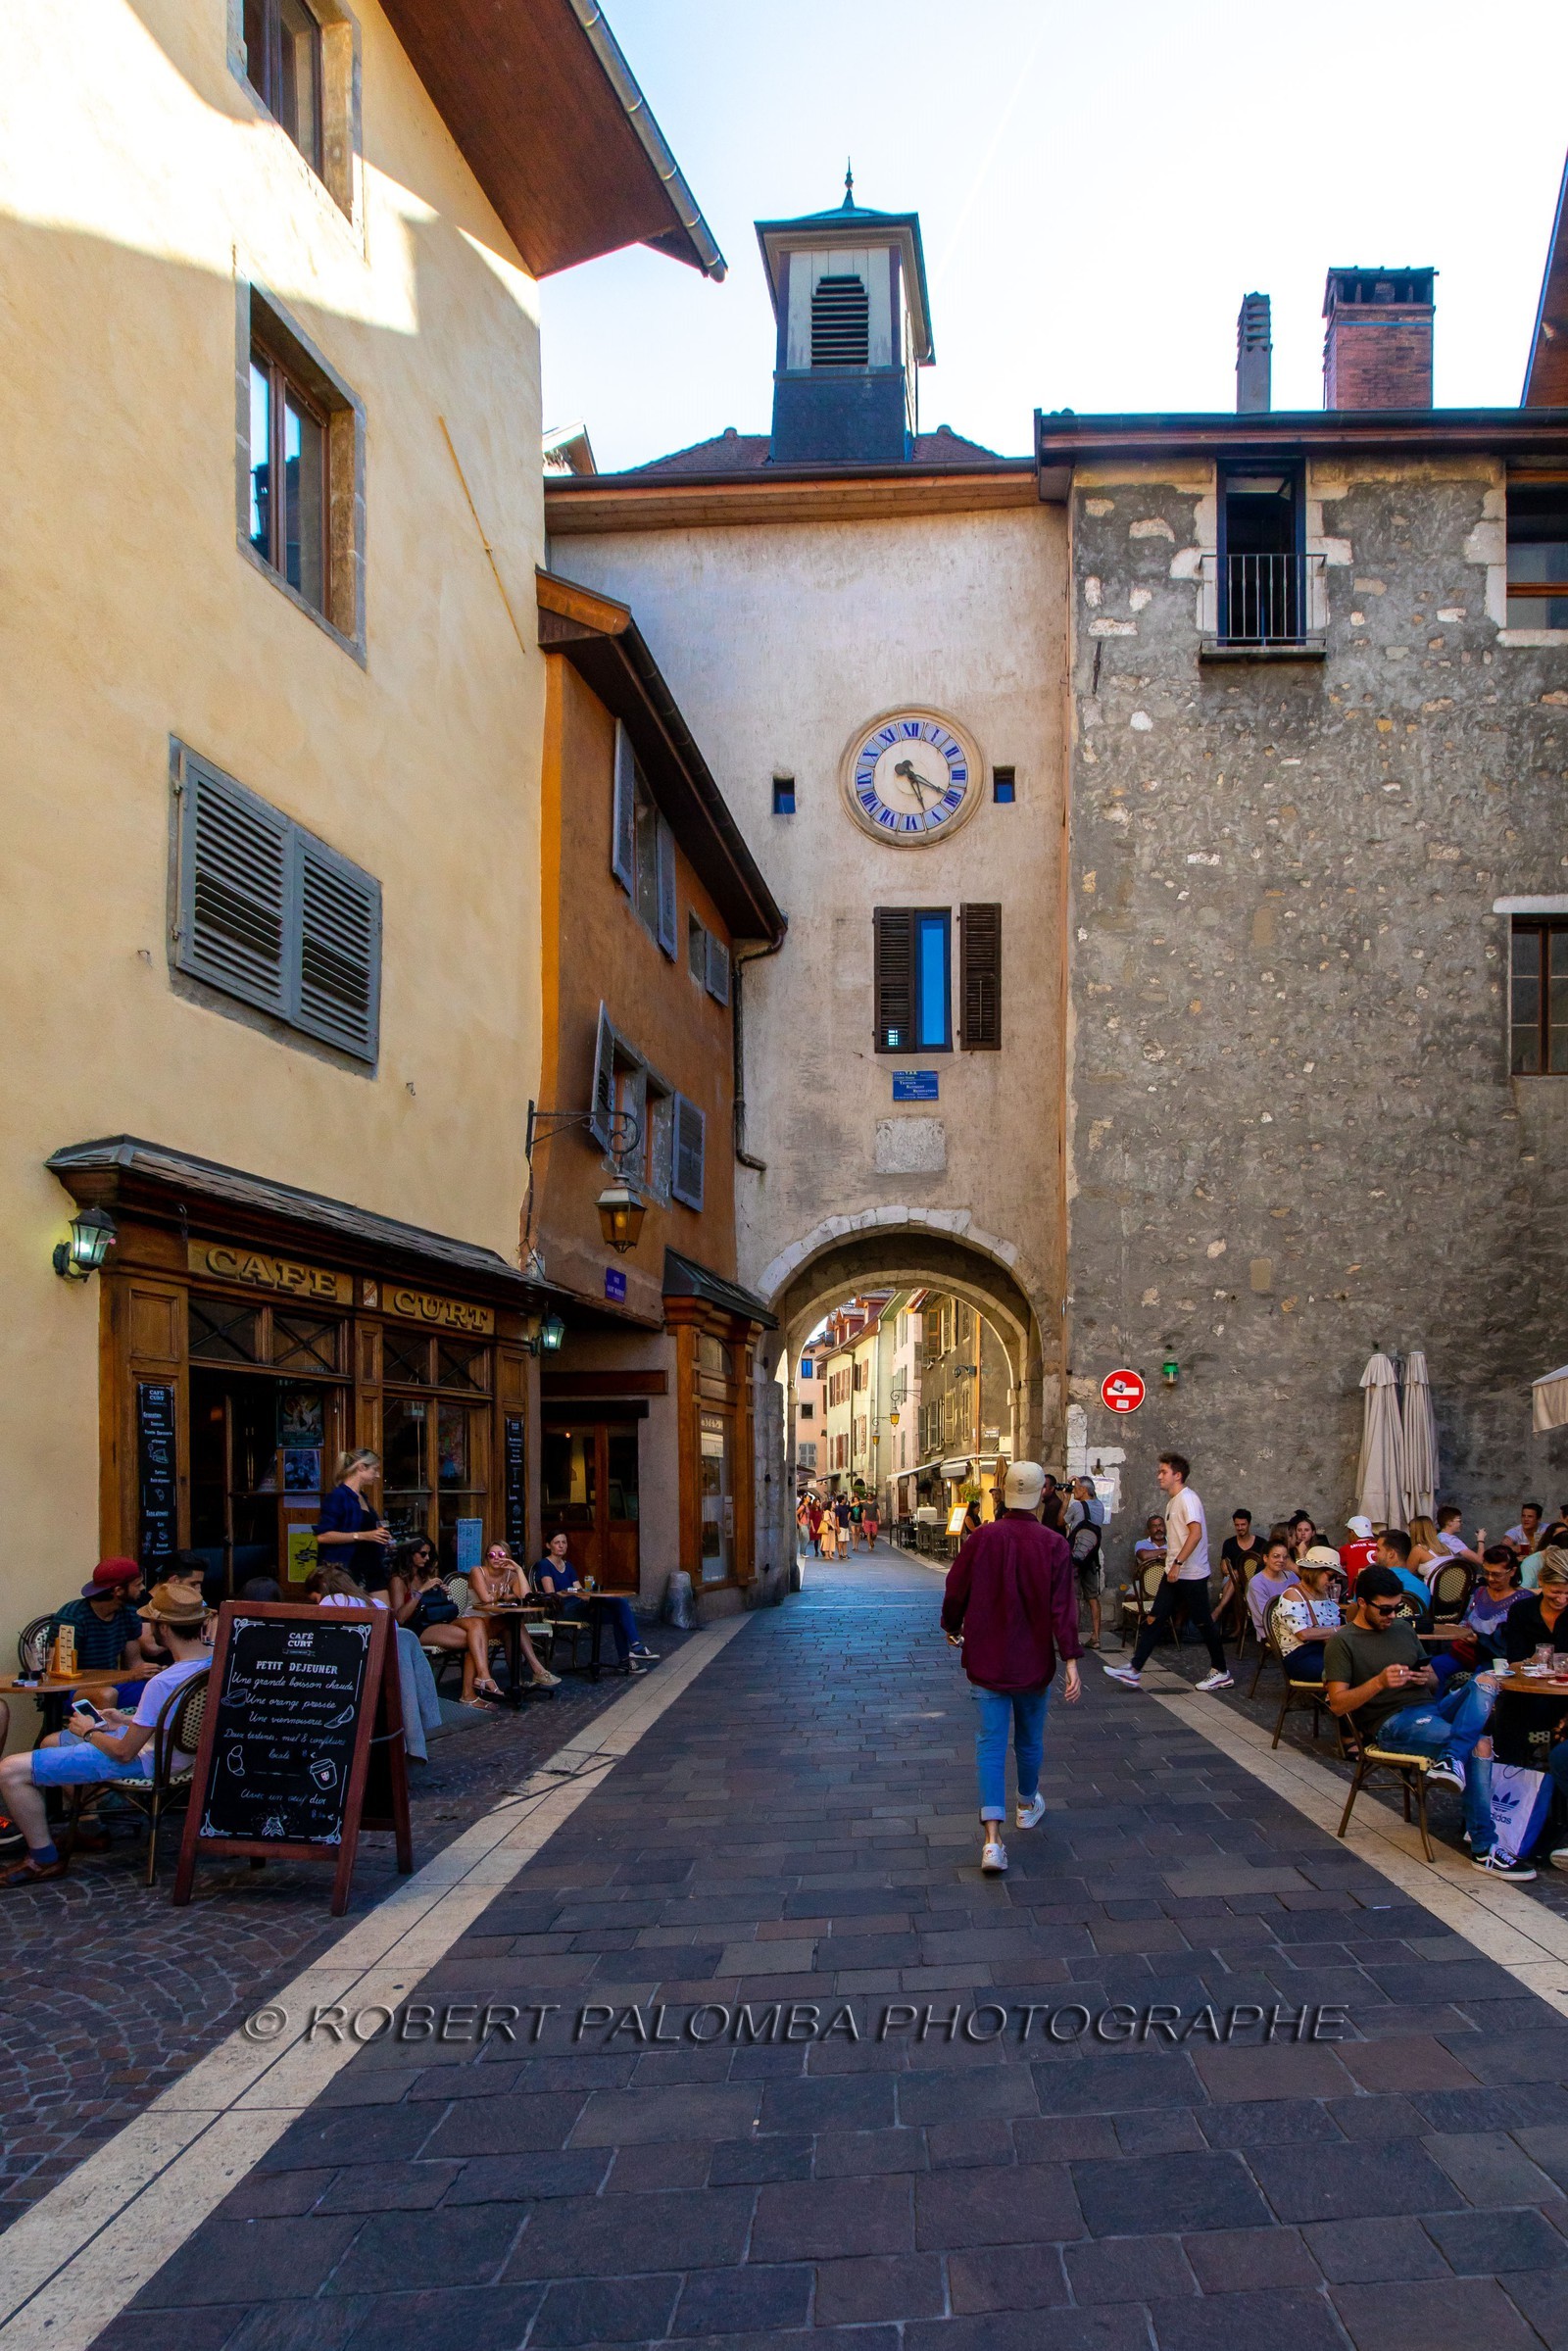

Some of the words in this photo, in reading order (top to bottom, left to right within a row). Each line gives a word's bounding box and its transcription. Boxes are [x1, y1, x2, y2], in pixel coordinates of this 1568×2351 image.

[902, 723, 919, 737] XII
[879, 729, 896, 747] XI
[862, 748, 878, 761] X
[945, 746, 959, 759] II
[952, 769, 966, 781] III
[906, 815, 918, 830] VI
[206, 1248, 337, 1299] CAFE
[394, 1290, 488, 1331] CURT
[289, 1632, 315, 1641] CAFÉ
[257, 1660, 284, 1671] PETIT
[289, 1661, 339, 1675] DEJEUNER
[232, 1671, 252, 1685] Une
[253, 1675, 287, 1691] grande
[289, 1676, 322, 1689] boisson
[326, 1679, 355, 1690] chaude
[246, 1692, 267, 1705] Une
[270, 1697, 300, 1711] orange
[249, 1710, 268, 1723] Une
[223, 1728, 245, 1739] Deux
[309, 1792, 326, 1805] dur
[1490, 1812, 1512, 1825] didas
